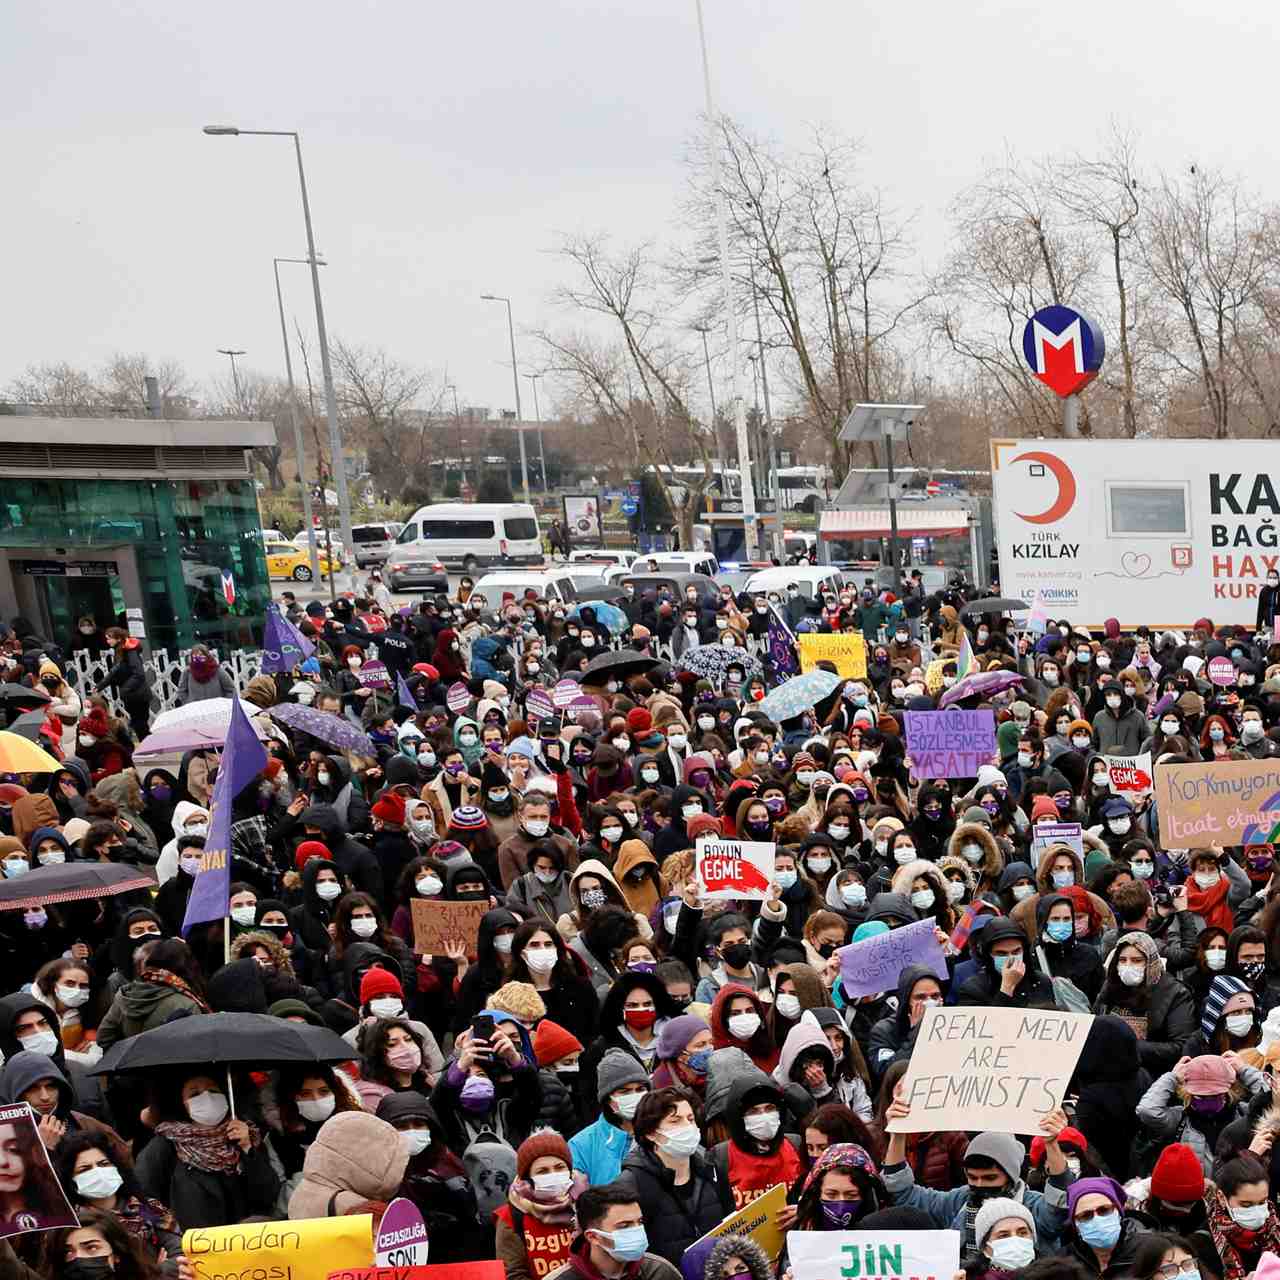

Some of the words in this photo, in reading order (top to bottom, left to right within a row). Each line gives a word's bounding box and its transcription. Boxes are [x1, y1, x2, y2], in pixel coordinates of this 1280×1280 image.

[1032, 532, 1061, 542] TÜRK
[1013, 544, 1080, 558] KIZILAY
[704, 845, 743, 861] BOYUN
[929, 1013, 994, 1043] REAL
[1015, 1016, 1079, 1047] MEN
[962, 1045, 1017, 1070] ARE
[909, 1075, 1061, 1114] FEMINISTS
[190, 1230, 301, 1255] Bundan
[379, 1221, 427, 1249] CEZASIZLIĞA
[525, 1228, 572, 1252] Özgü
[387, 1245, 418, 1267] SON!
[840, 1244, 904, 1278] JİN
